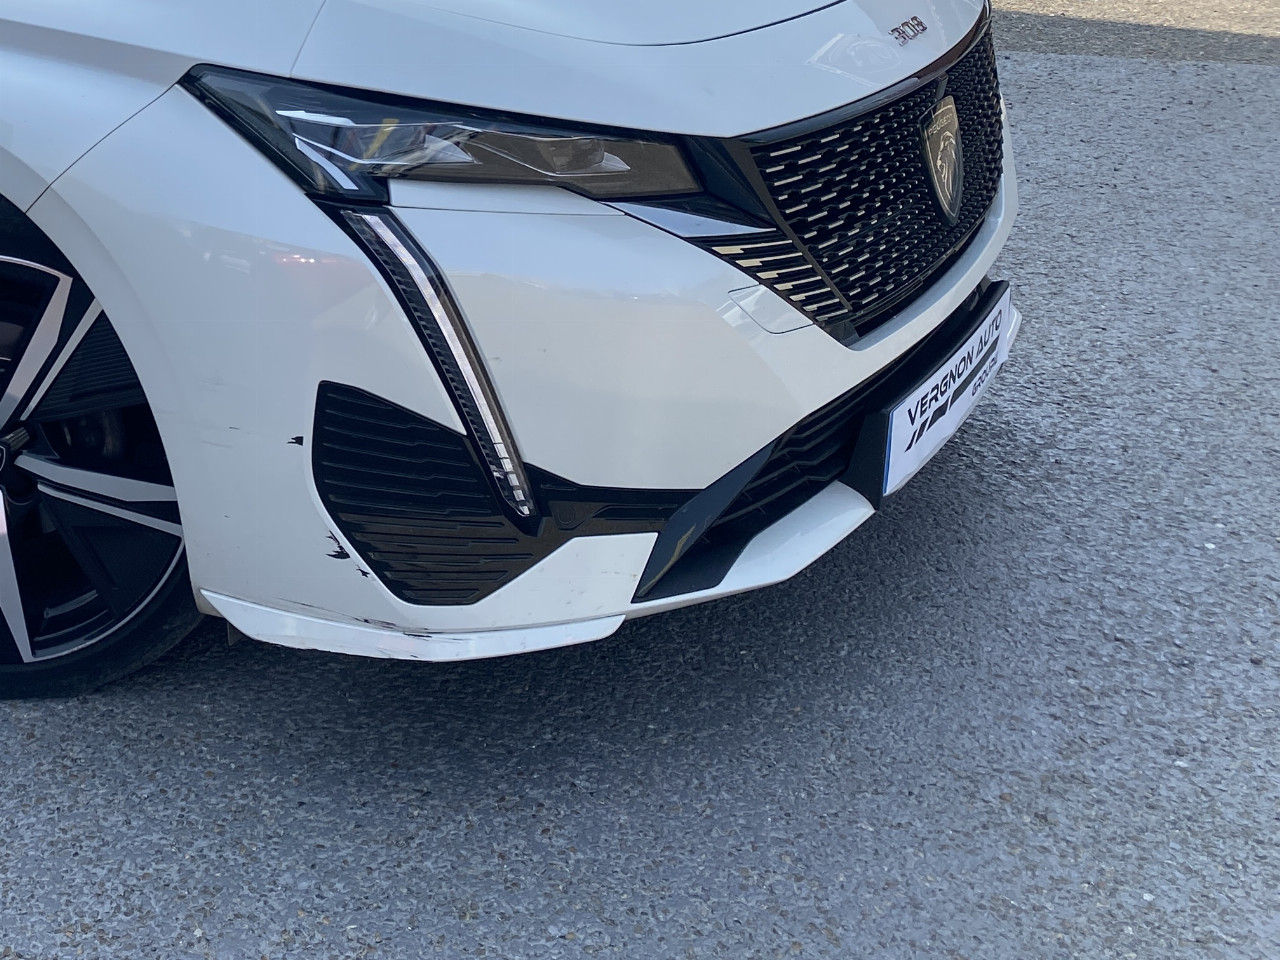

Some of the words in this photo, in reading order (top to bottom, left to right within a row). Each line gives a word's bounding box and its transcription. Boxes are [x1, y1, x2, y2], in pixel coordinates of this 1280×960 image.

[888, 15, 928, 47] 308
[907, 345, 974, 427] VERGNON
[976, 309, 1002, 358] AUTO
